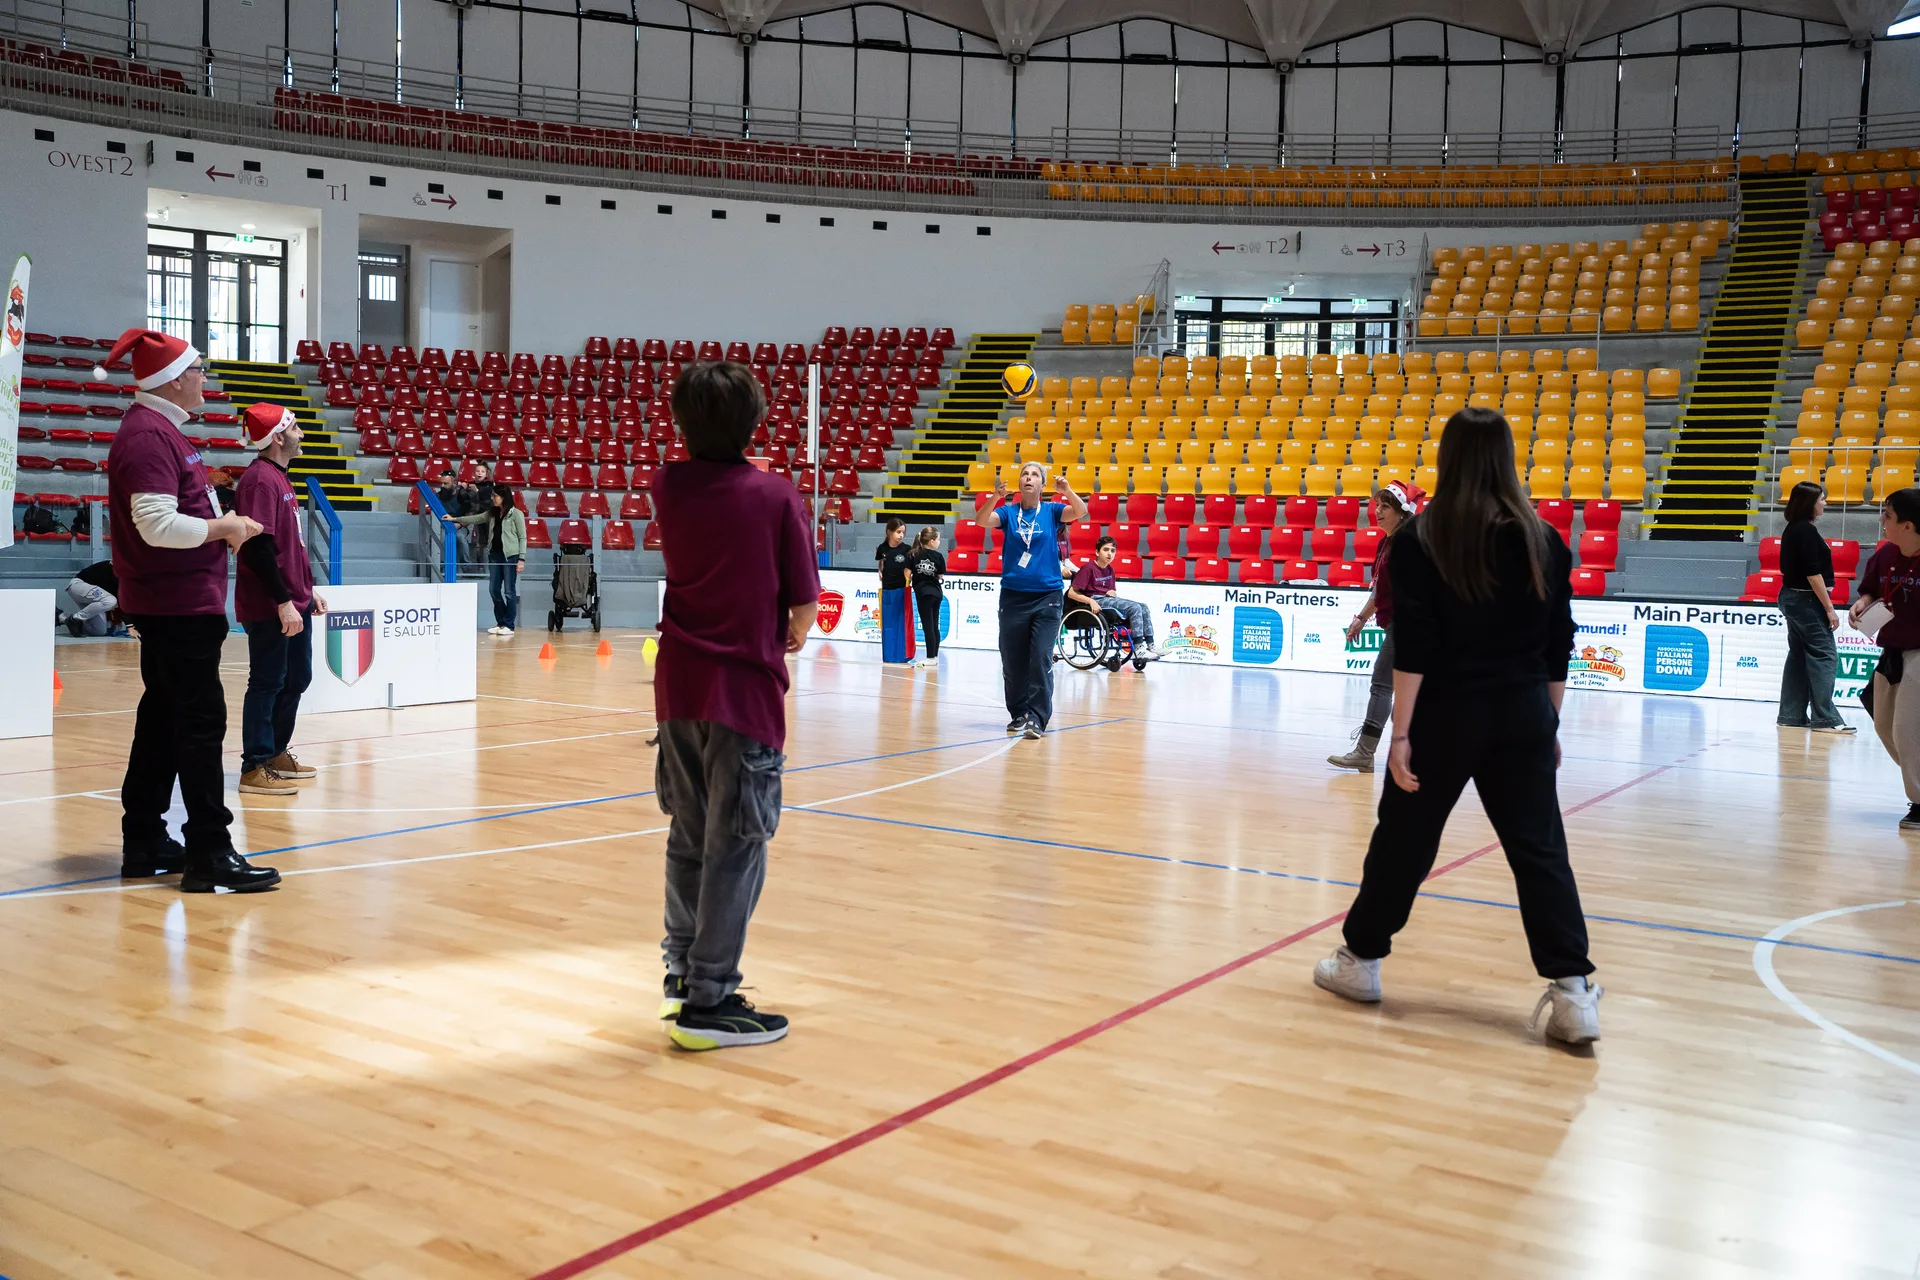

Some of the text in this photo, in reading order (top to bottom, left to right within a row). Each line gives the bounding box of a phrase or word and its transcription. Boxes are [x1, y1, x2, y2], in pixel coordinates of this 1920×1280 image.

[326, 184, 348, 202] T1
[1266, 238, 1288, 254] T2
[1384, 240, 1406, 256] T3
[1225, 589, 1339, 607] Main Partners:
[1164, 603, 1214, 615] Animundi
[330, 614, 370, 627] ITALIA
[384, 608, 440, 624] SPORT
[1634, 606, 1784, 626] Main Partners:
[384, 624, 440, 638] E SALUTE
[1576, 624, 1620, 634] mundi
[1242, 641, 1271, 650] DOWN
[1838, 636, 1866, 644] DELLA
[1656, 658, 1693, 667] PERSONE
[1656, 665, 1692, 676] DOWN
